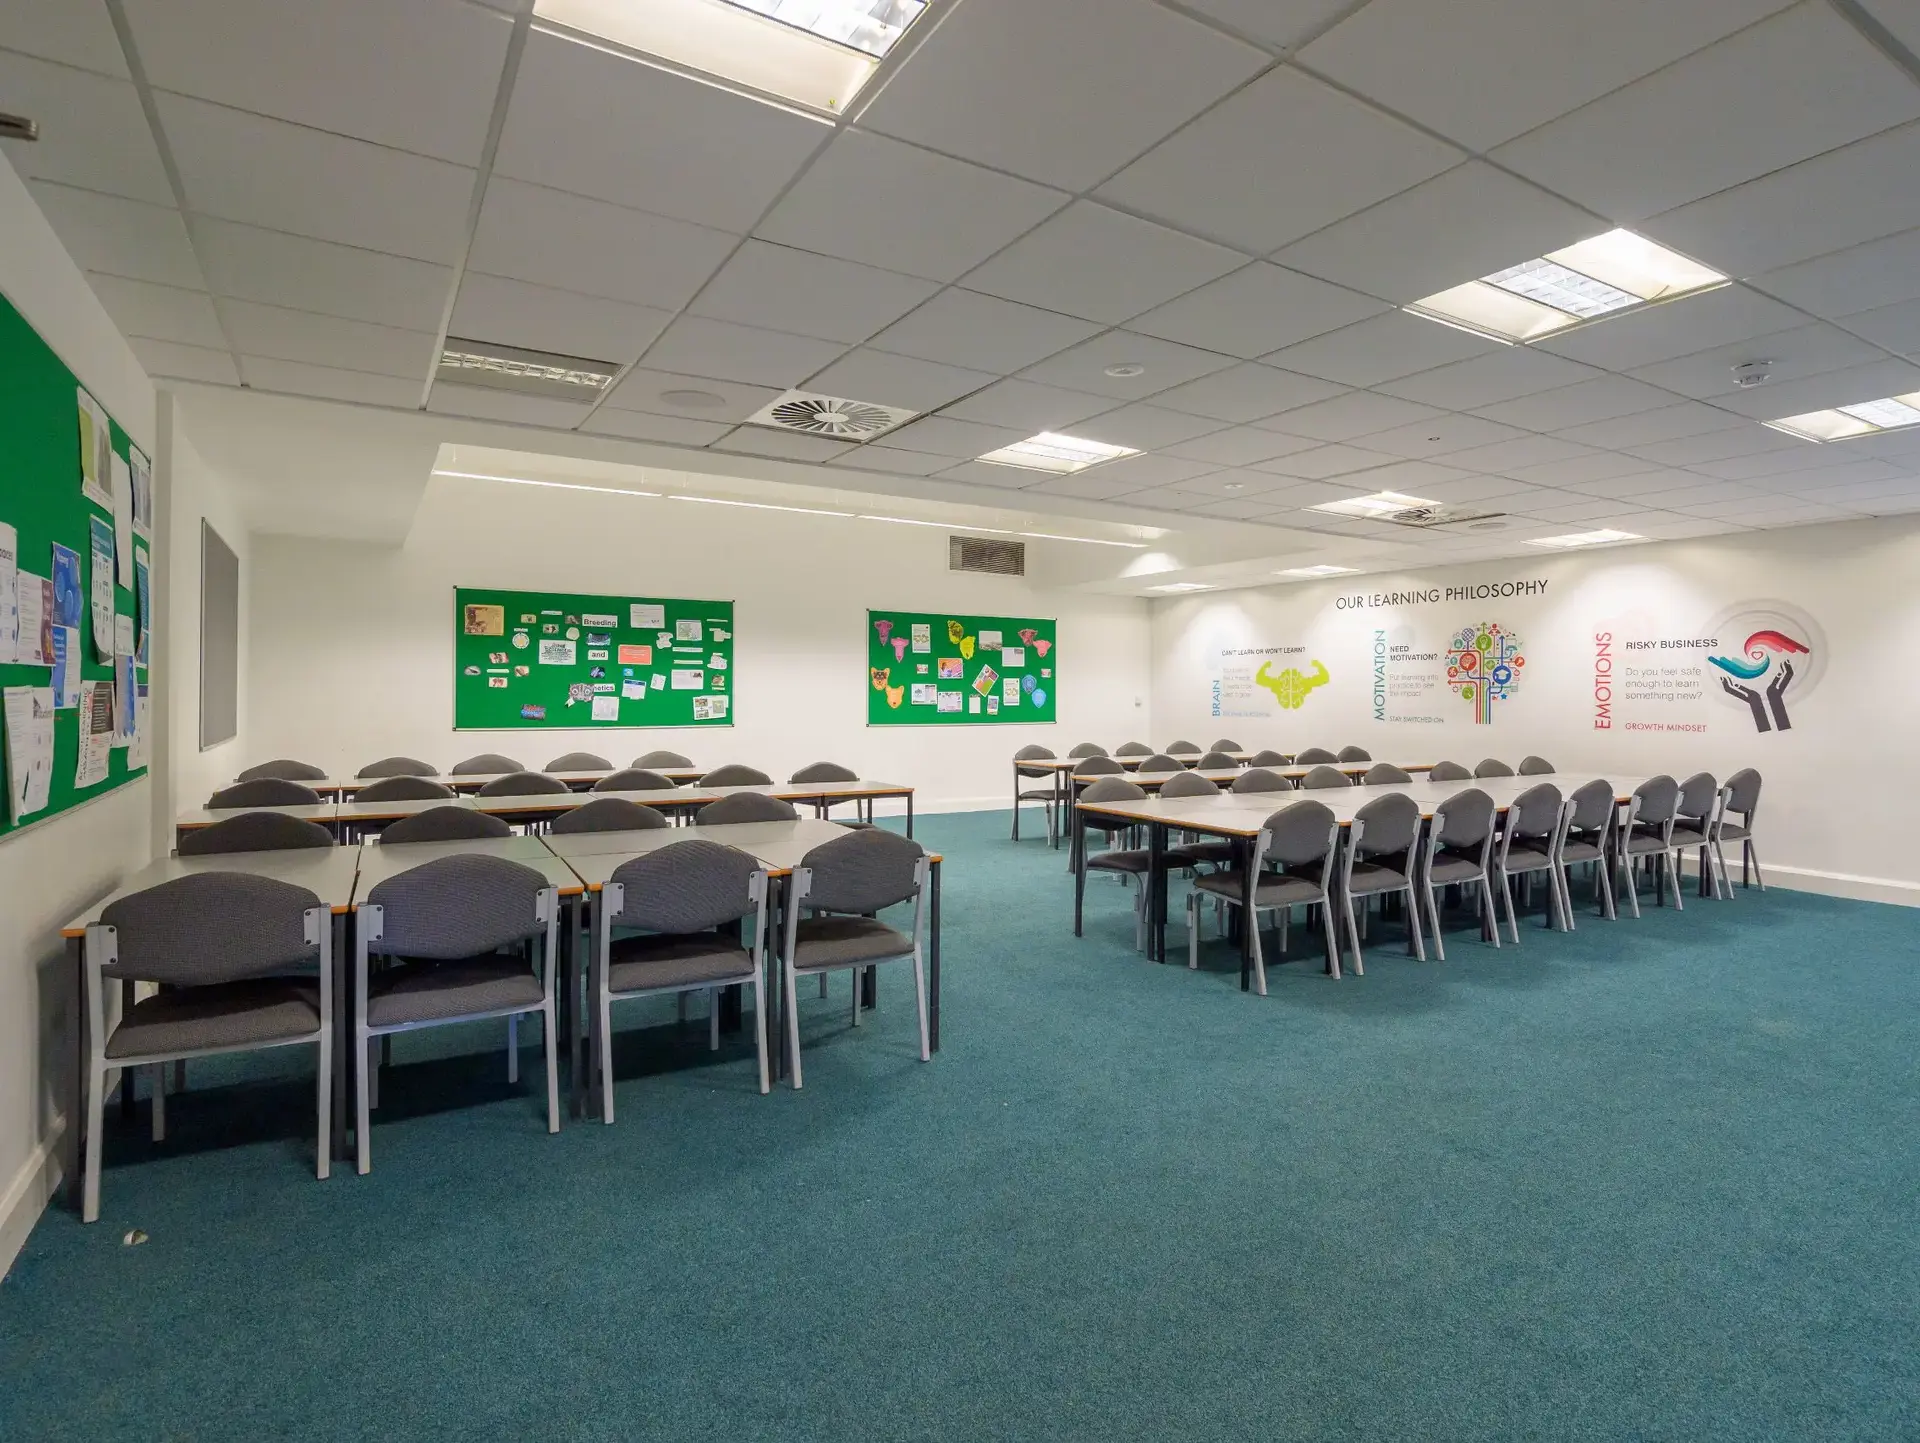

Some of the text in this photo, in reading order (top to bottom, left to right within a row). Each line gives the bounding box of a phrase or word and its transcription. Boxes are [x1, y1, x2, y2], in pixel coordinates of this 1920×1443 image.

[1336, 579, 1549, 610] OUR LEARNING PHILOSOPHY
[583, 618, 617, 627] Breeding
[1283, 646, 1306, 654] LEARN?
[1626, 639, 1718, 650] RISKY BUSINESS
[1389, 645, 1438, 661] NEED MOTIVATION?
[1374, 630, 1386, 721] MOTIVATION
[1625, 667, 1702, 678] Do you feel safe
[1594, 632, 1612, 729] EMOTIONS
[1625, 679, 1700, 689] enough to learn
[1212, 680, 1221, 716] BRAIN
[1625, 691, 1703, 702] something new?
[1625, 722, 1707, 732] GROWTH MINDSET
